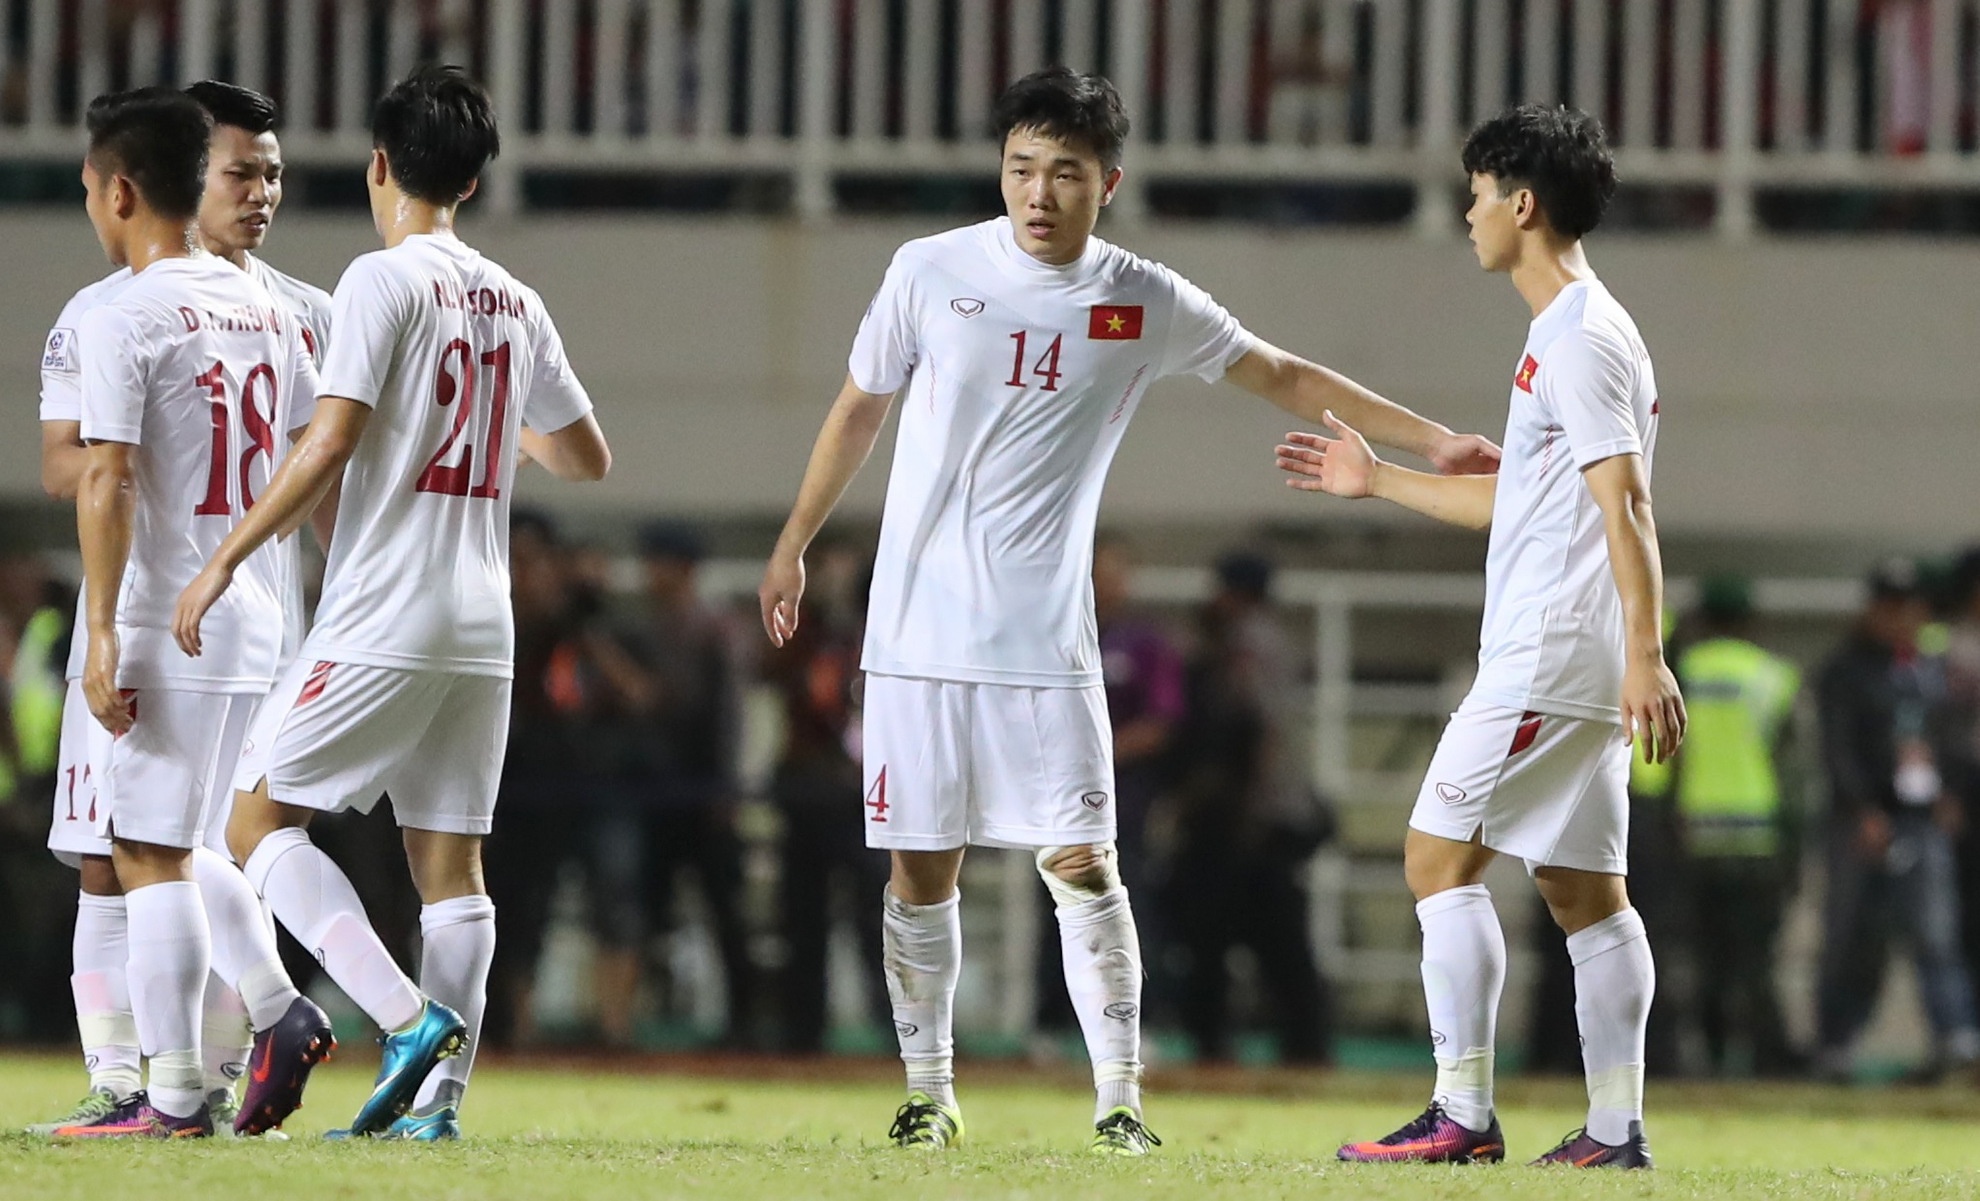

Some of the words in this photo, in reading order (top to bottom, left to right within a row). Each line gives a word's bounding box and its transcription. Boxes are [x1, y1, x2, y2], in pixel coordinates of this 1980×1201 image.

[1005, 330, 1062, 391] 14
[195, 360, 278, 516] 18
[416, 338, 510, 499] 21
[66, 764, 97, 822] 17
[866, 764, 889, 822] 4
